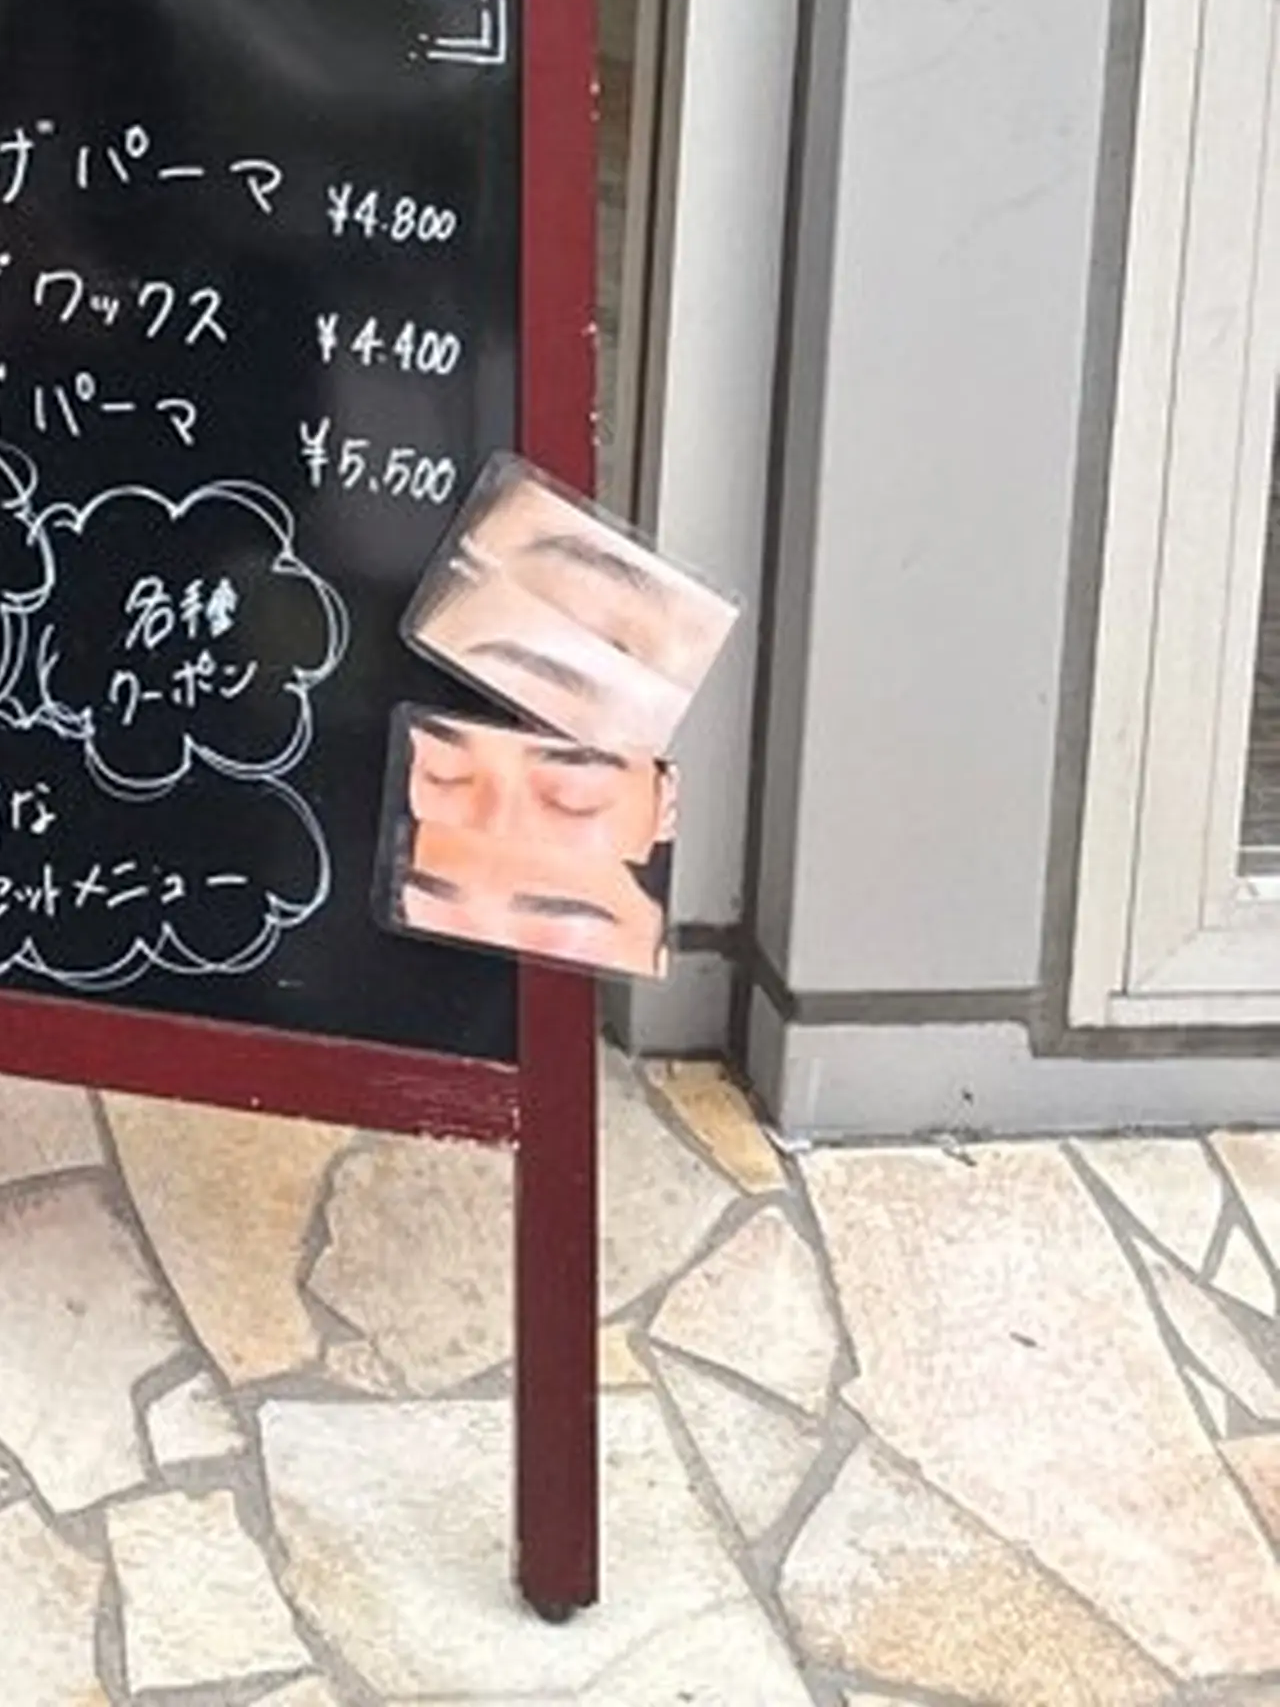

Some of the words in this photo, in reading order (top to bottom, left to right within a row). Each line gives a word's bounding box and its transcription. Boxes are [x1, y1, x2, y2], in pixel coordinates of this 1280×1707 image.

[124, 575, 239, 651] 各種
[108, 649, 259, 725] クーポン
